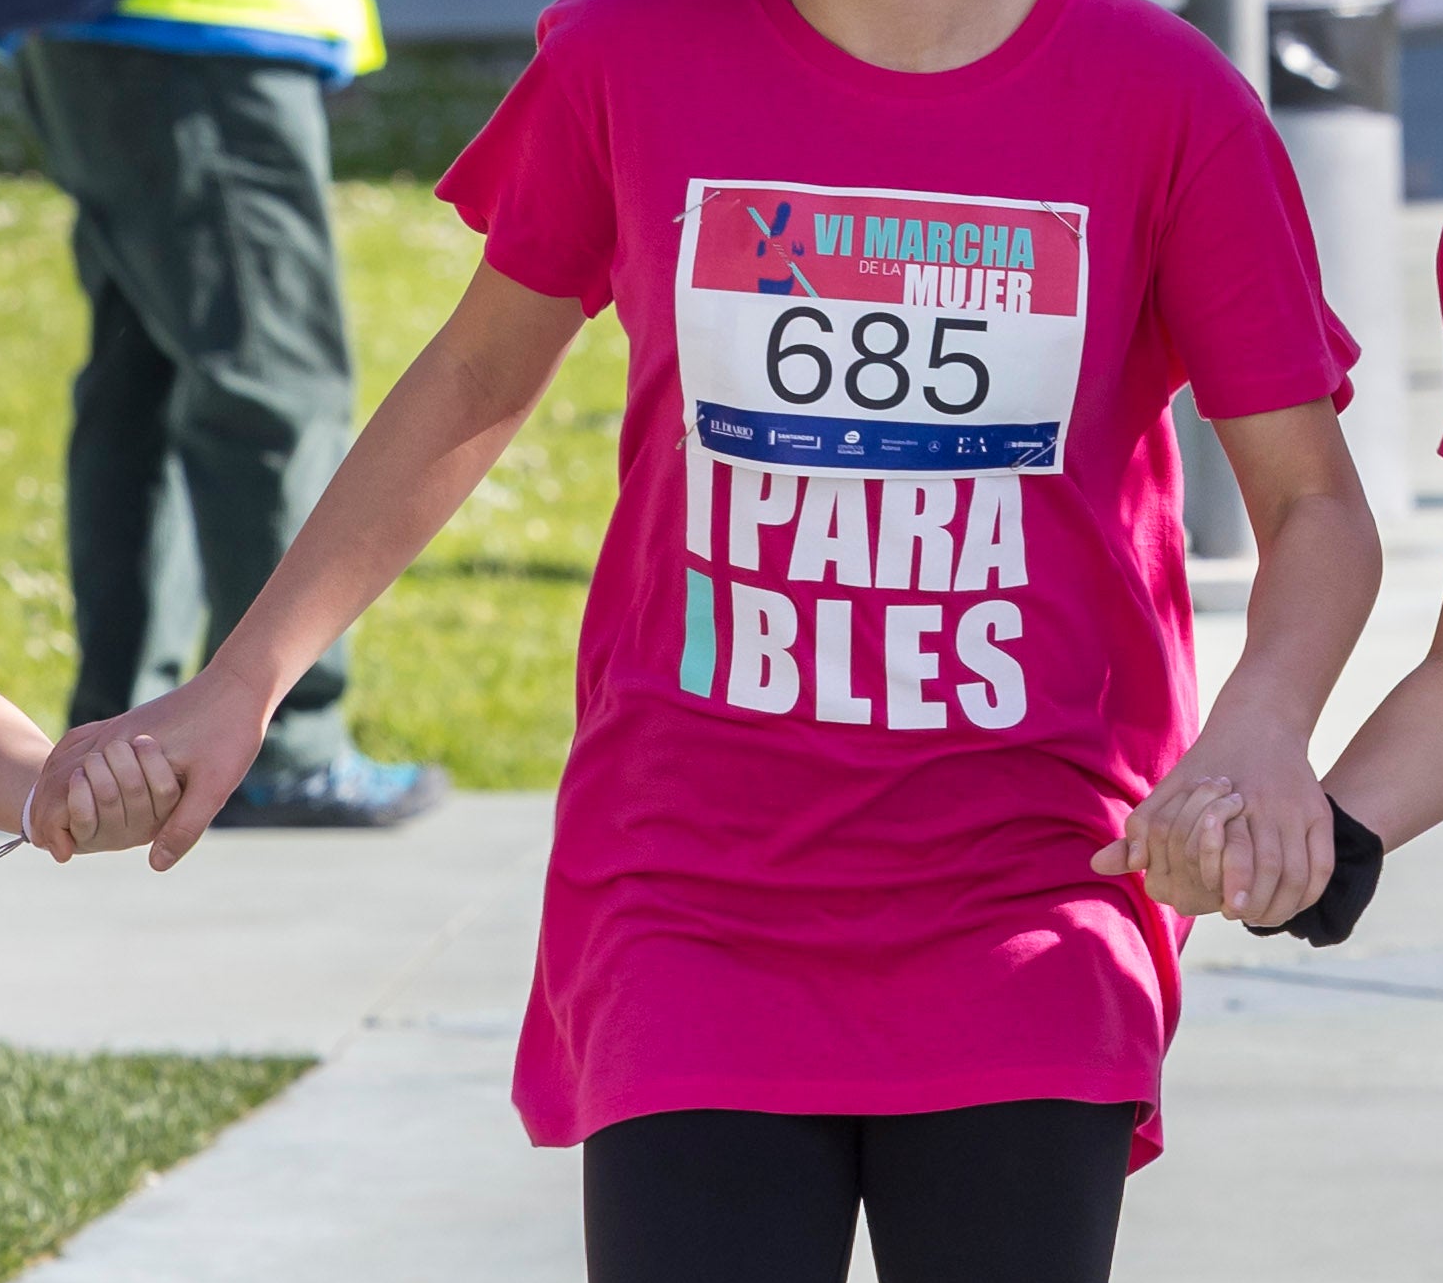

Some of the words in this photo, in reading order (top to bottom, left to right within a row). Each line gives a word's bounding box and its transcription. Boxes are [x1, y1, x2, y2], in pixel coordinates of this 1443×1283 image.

[813, 212, 853, 258] VI
[864, 217, 1035, 270] MARCHA
[858, 259, 880, 275] DE
[881, 260, 902, 277] LA
[902, 261, 1033, 315] MUJER
[765, 305, 991, 416] 685
